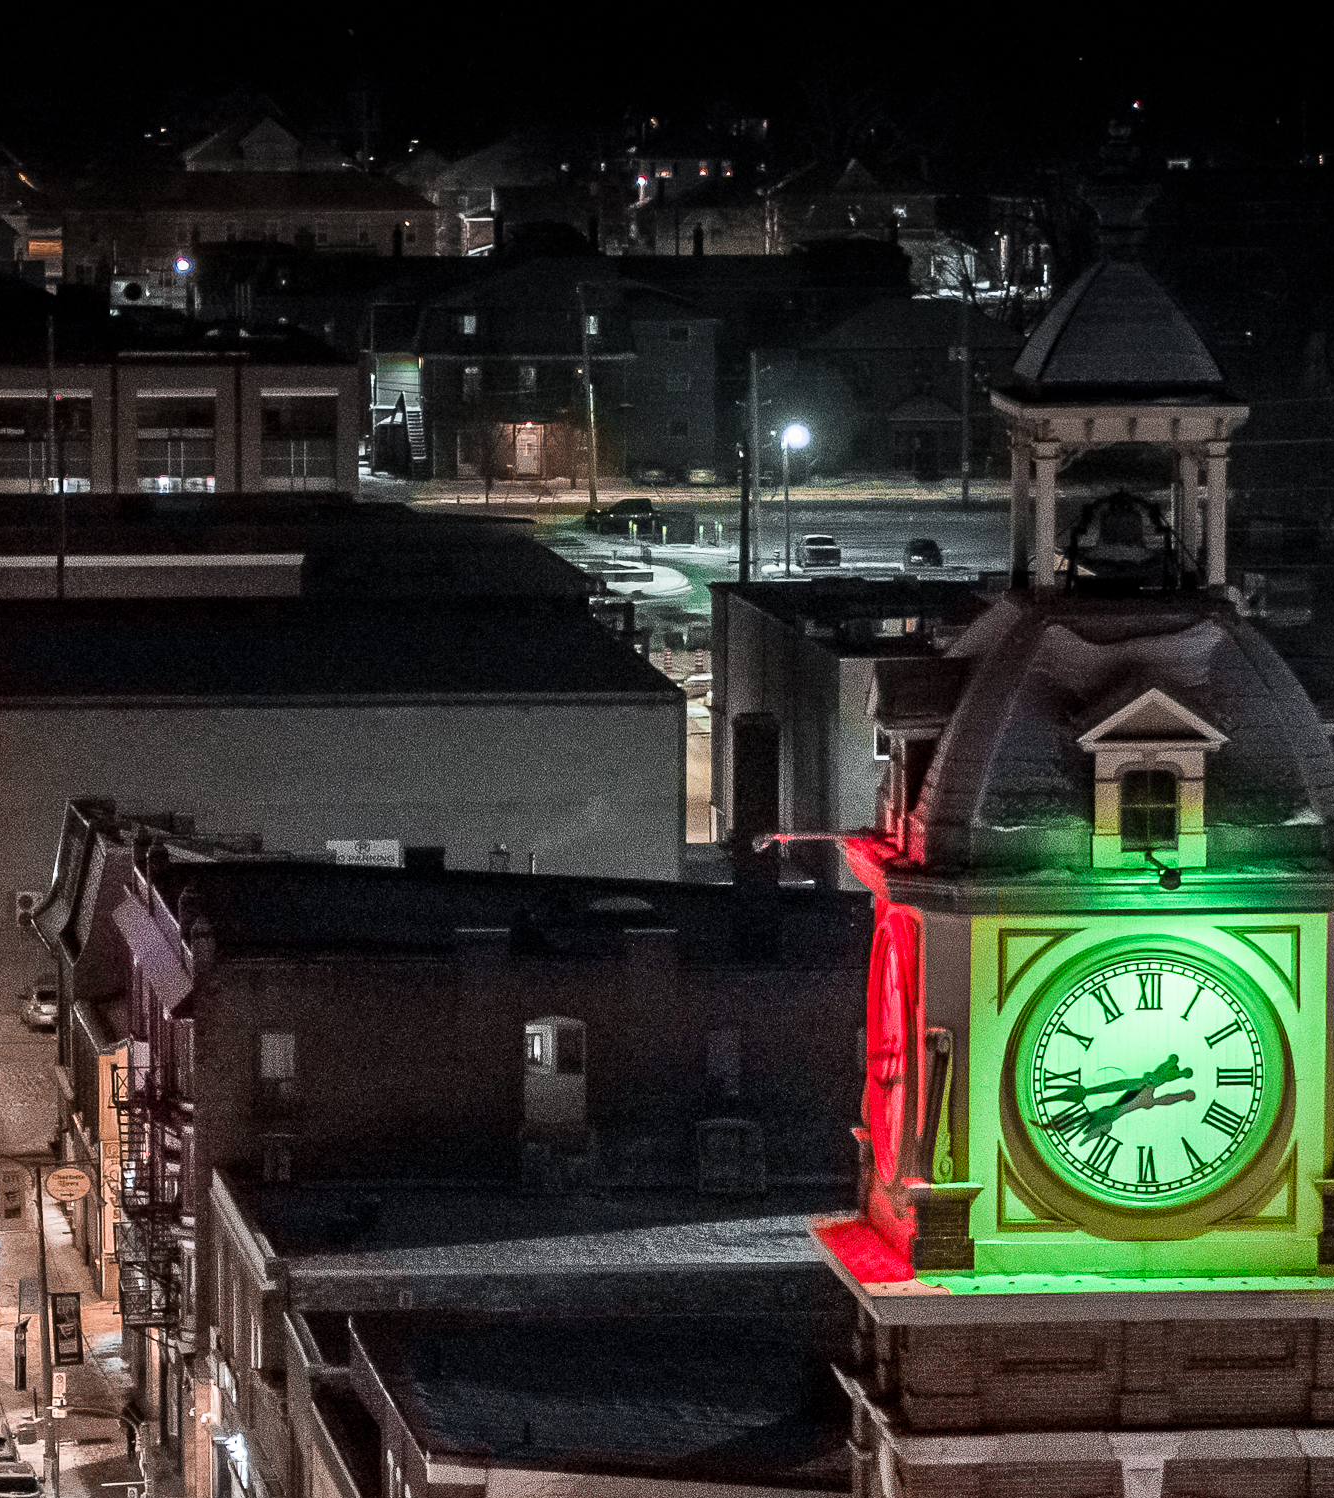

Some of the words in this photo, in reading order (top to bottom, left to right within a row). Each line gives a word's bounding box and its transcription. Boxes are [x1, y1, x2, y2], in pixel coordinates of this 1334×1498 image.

[1089, 983, 1124, 1024] XI
[1136, 973, 1163, 1010] XII
[1181, 984, 1205, 1020] I
[1056, 1020, 1093, 1051] X
[1205, 1019, 1242, 1048] II
[1044, 1068, 1081, 1090] IX
[1217, 1066, 1254, 1088] III
[1202, 1100, 1245, 1138] IIII
[1084, 1131, 1123, 1176] VII
[1137, 1145, 1158, 1183] VI
[1181, 1137, 1208, 1172] V
